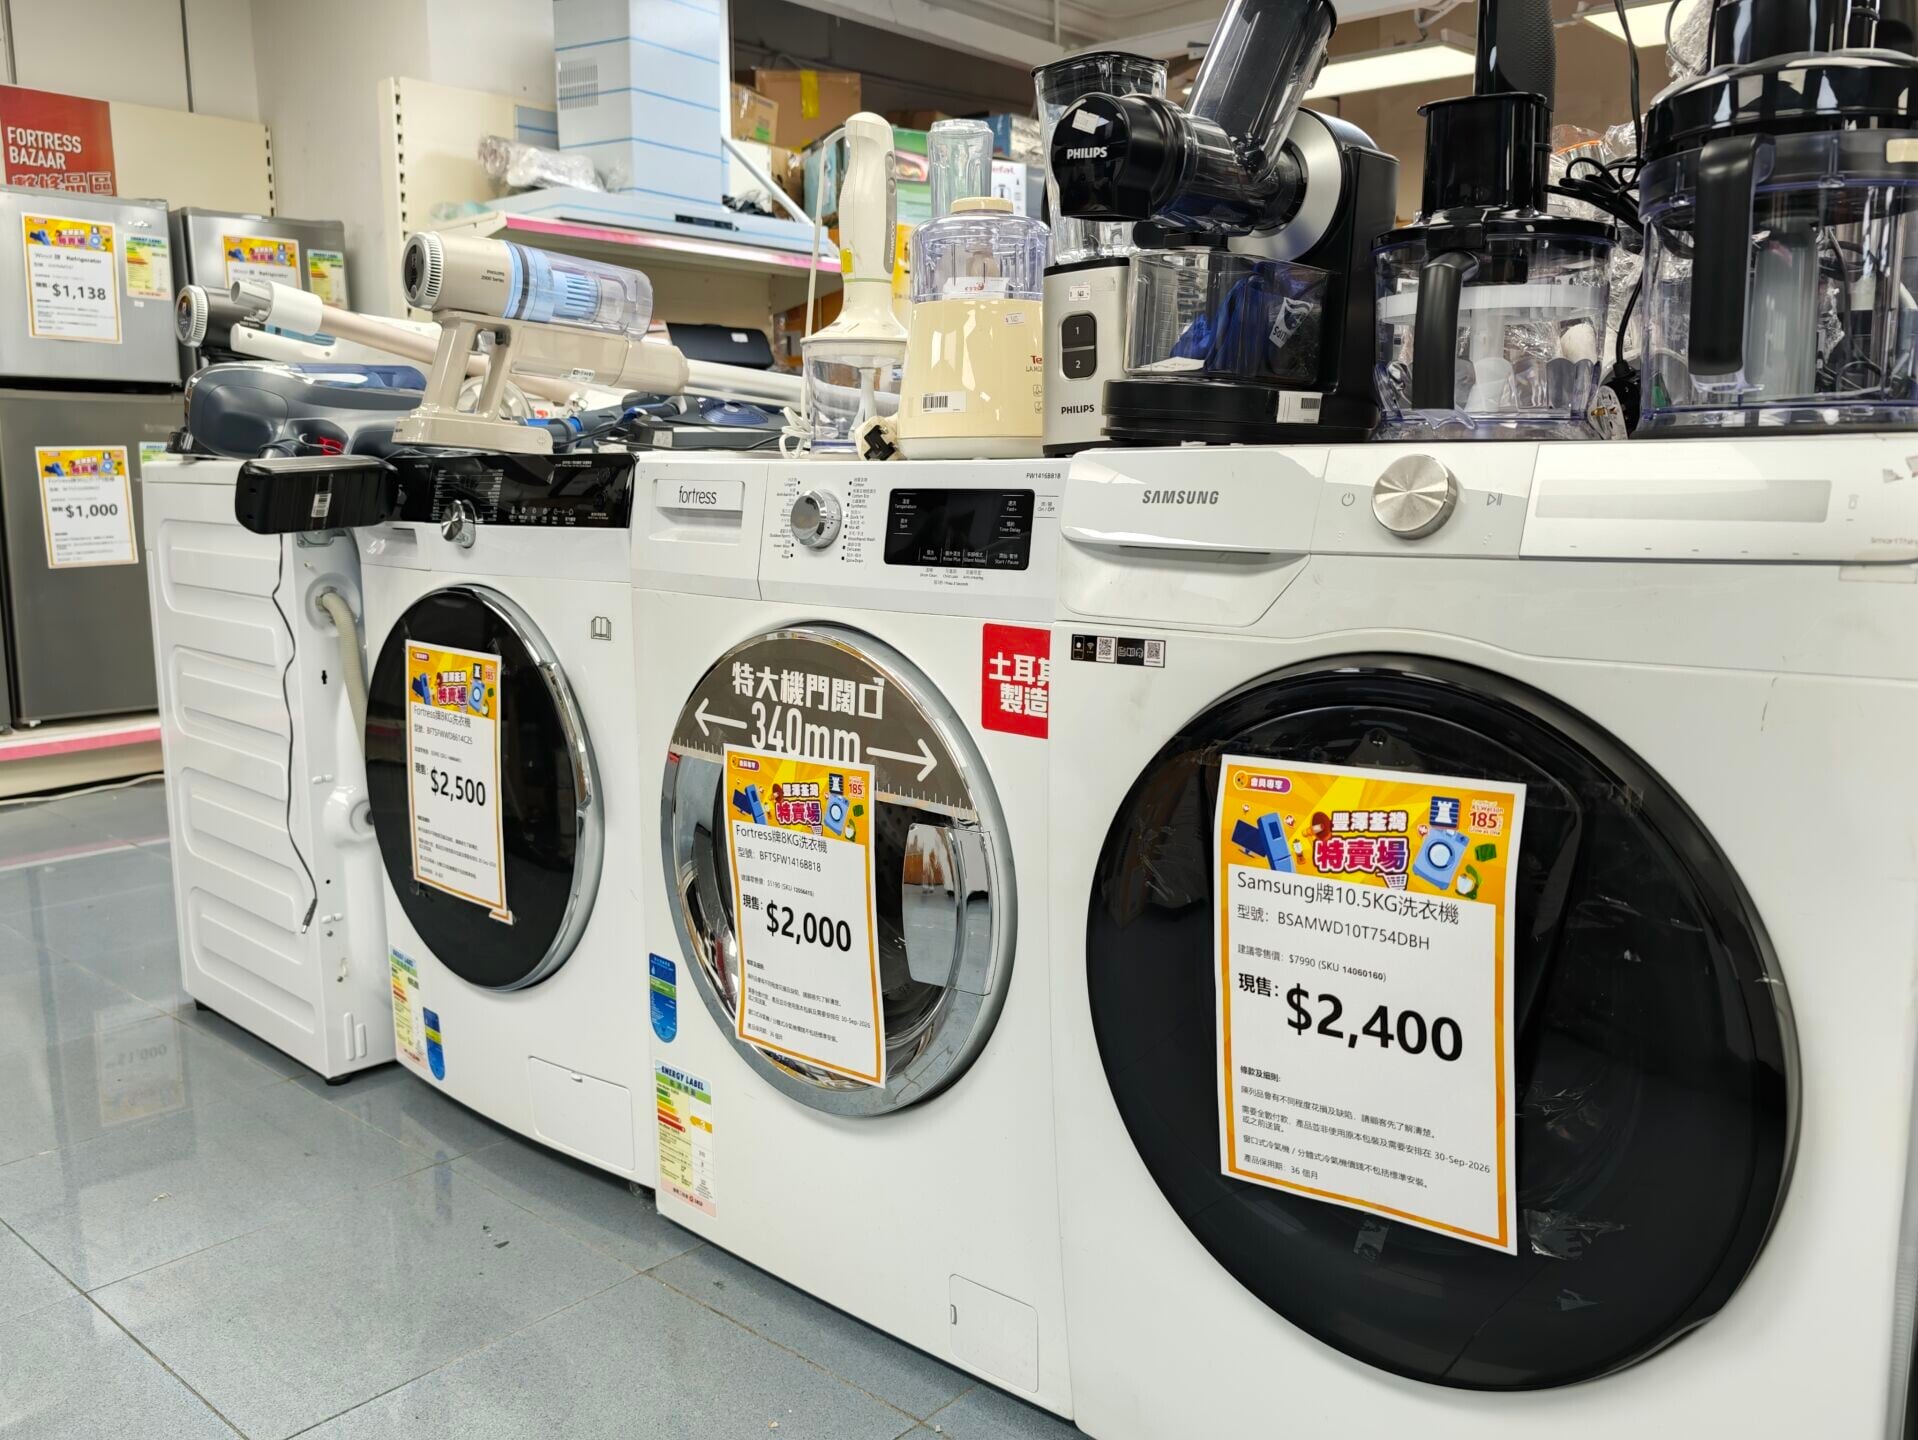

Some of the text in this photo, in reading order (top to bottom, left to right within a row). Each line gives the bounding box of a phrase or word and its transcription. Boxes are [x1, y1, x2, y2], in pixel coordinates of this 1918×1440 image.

[7, 126, 82, 154] FORTRESS
[1066, 146, 1107, 159] PHILIPS
[9, 145, 66, 170] BAZAAR
[52, 281, 107, 301] $1,138
[1075, 326, 1080, 335] 1
[1075, 360, 1081, 369] 2
[1060, 404, 1095, 415] PHILIPS
[678, 485, 718, 505] fortress
[1142, 490, 1219, 505] SAMSUNG
[65, 503, 118, 519] $1,000
[1000, 683, 1049, 719] 製造
[750, 701, 861, 765] 340mm
[430, 765, 486, 807] $2,500
[849, 783, 863, 795] 185
[776, 800, 822, 826] 特賣場
[1469, 811, 1498, 829] 185
[735, 824, 828, 855] Fortress牌8KG洗衣機
[1314, 836, 1409, 875] 特賣場
[1237, 871, 1460, 926] Samsung牌10.5KG洗衣機
[766, 899, 852, 952] $2,000
[1277, 911, 1430, 951] BSAMWD10T754DBH
[1288, 954, 1316, 968] $7990
[1318, 959, 1340, 973] (SKU
[1342, 965, 1387, 983] 14060160)
[1286, 983, 1464, 1062] $2,400
[661, 1065, 705, 1091] ENERGY LABEL
[1290, 1165, 1301, 1175] 36
[1434, 1151, 1491, 1174] 30-Sep-2026
